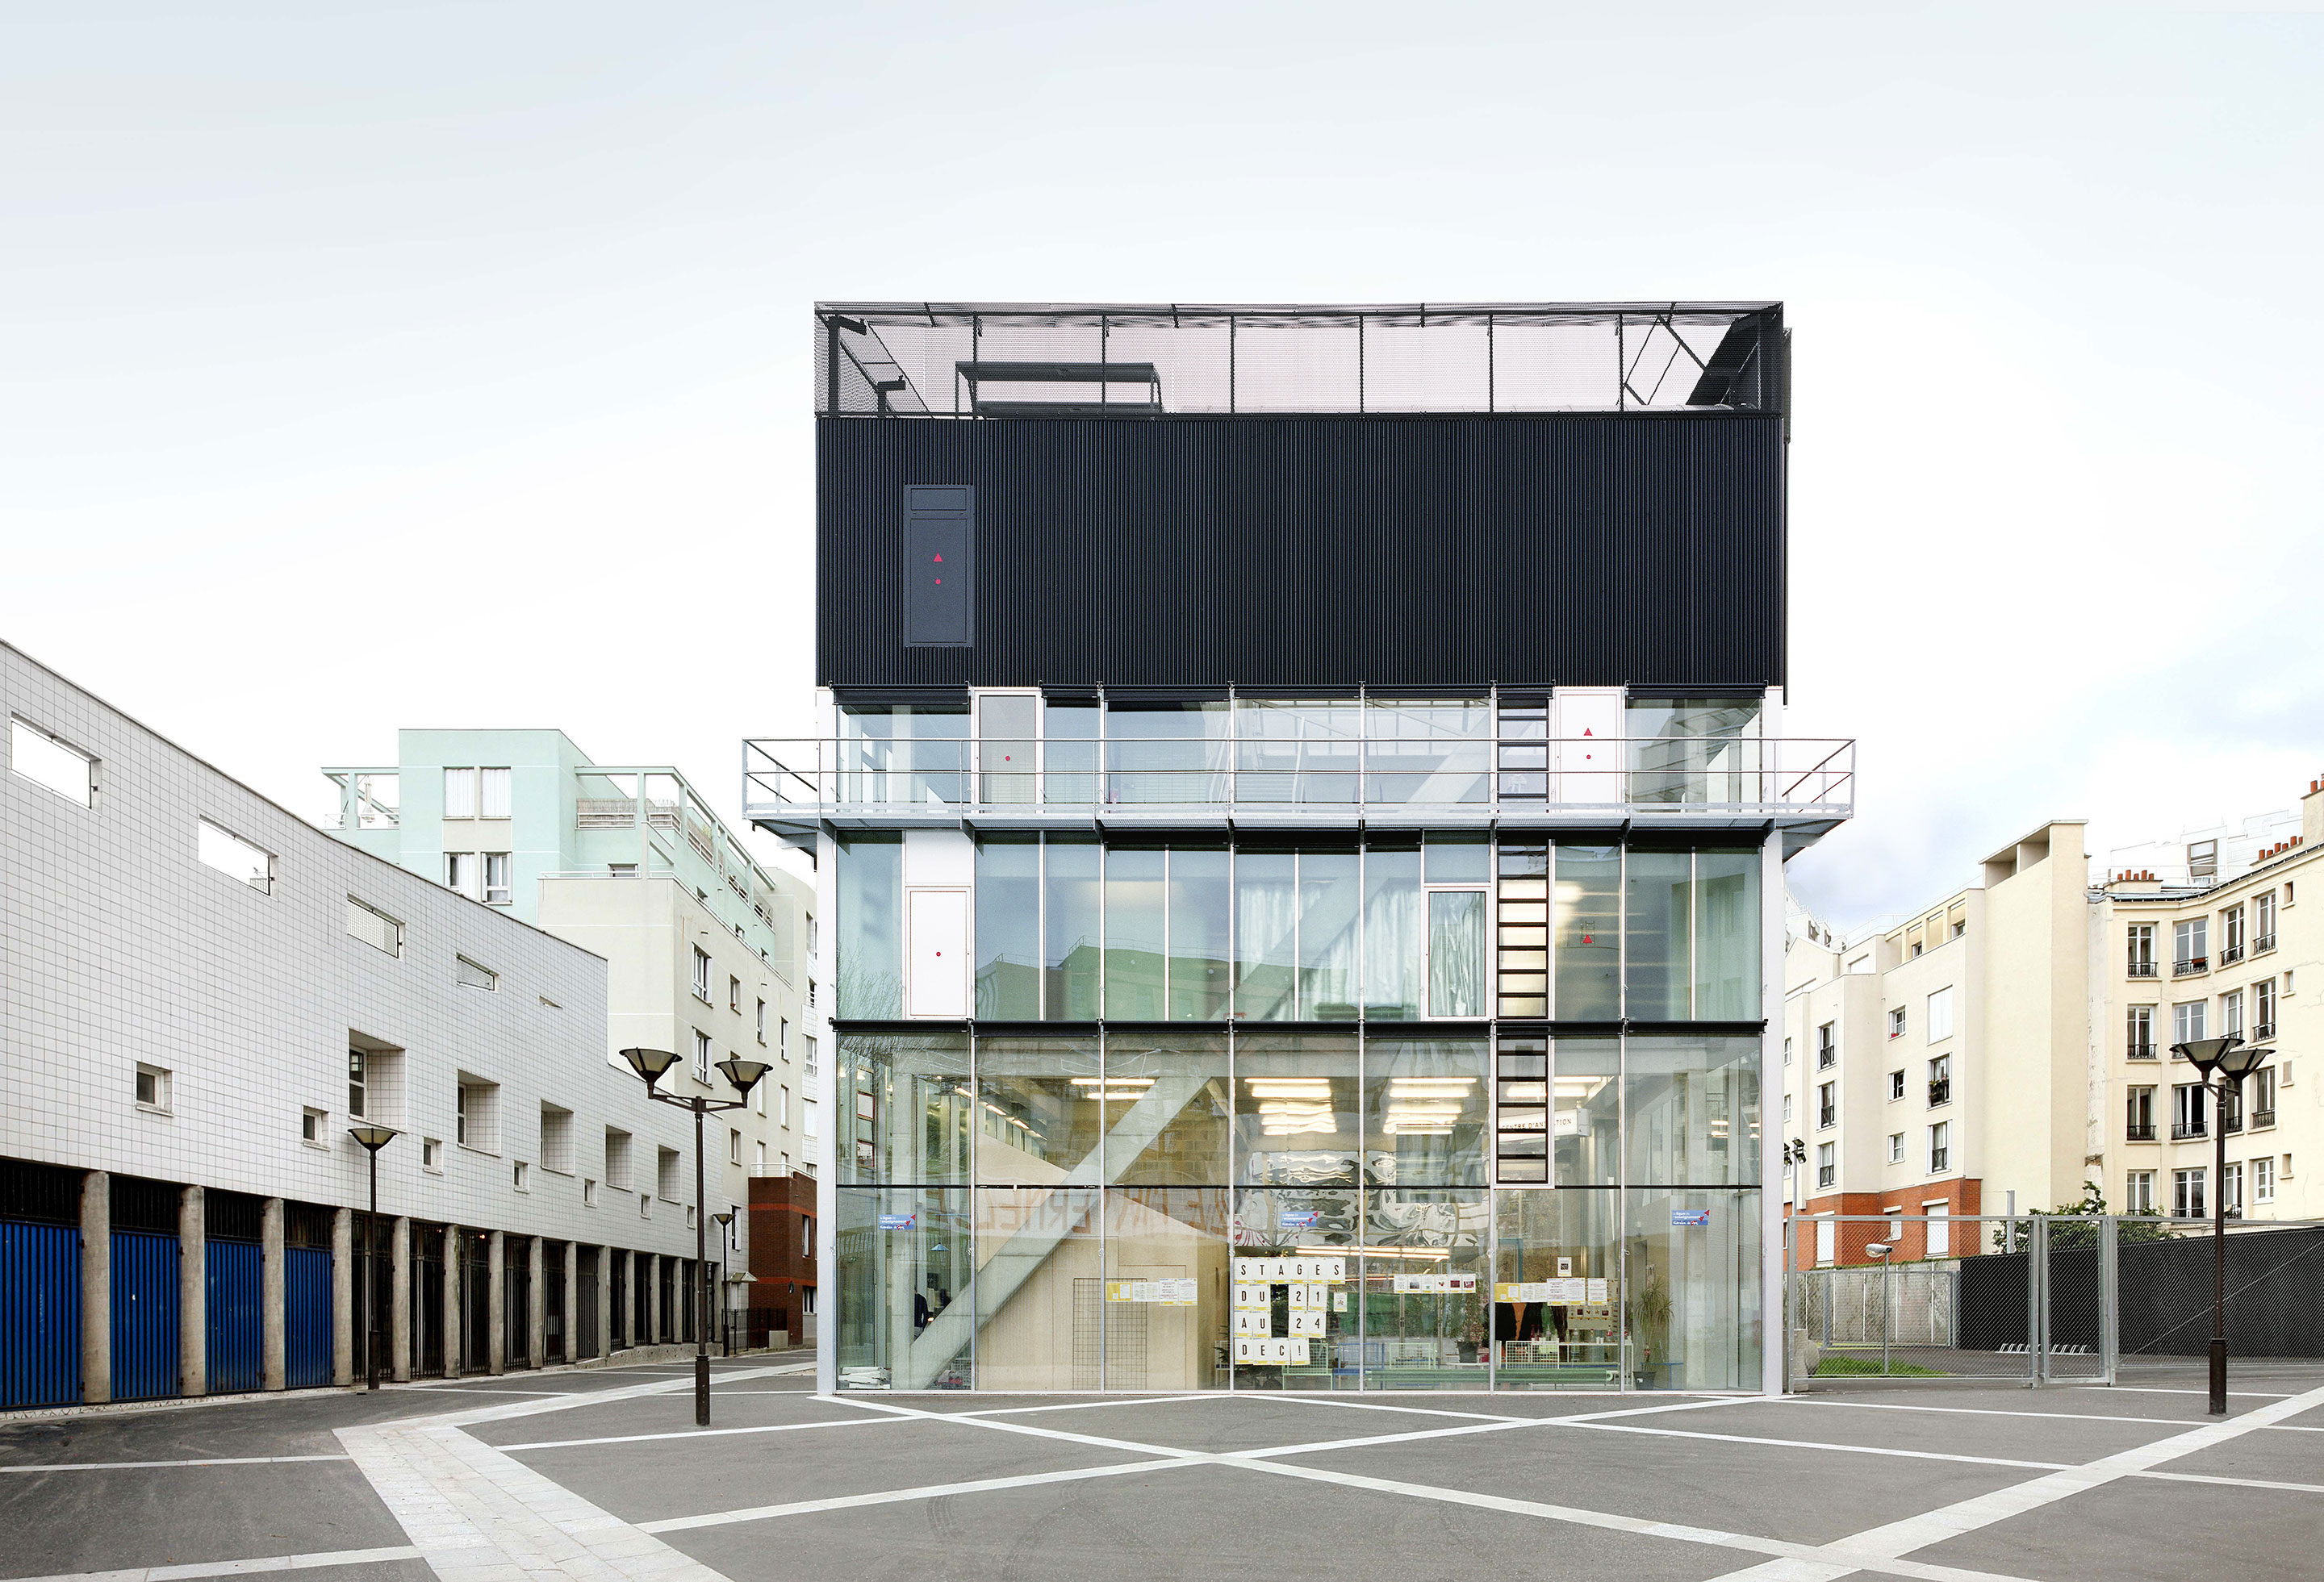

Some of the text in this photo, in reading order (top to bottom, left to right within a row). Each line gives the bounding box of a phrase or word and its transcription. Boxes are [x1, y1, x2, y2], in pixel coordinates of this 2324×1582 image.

[1241, 1264, 1340, 1275] STAGES
[1241, 1291, 1319, 1302] DU 21
[1241, 1317, 1320, 1329] AU 24
